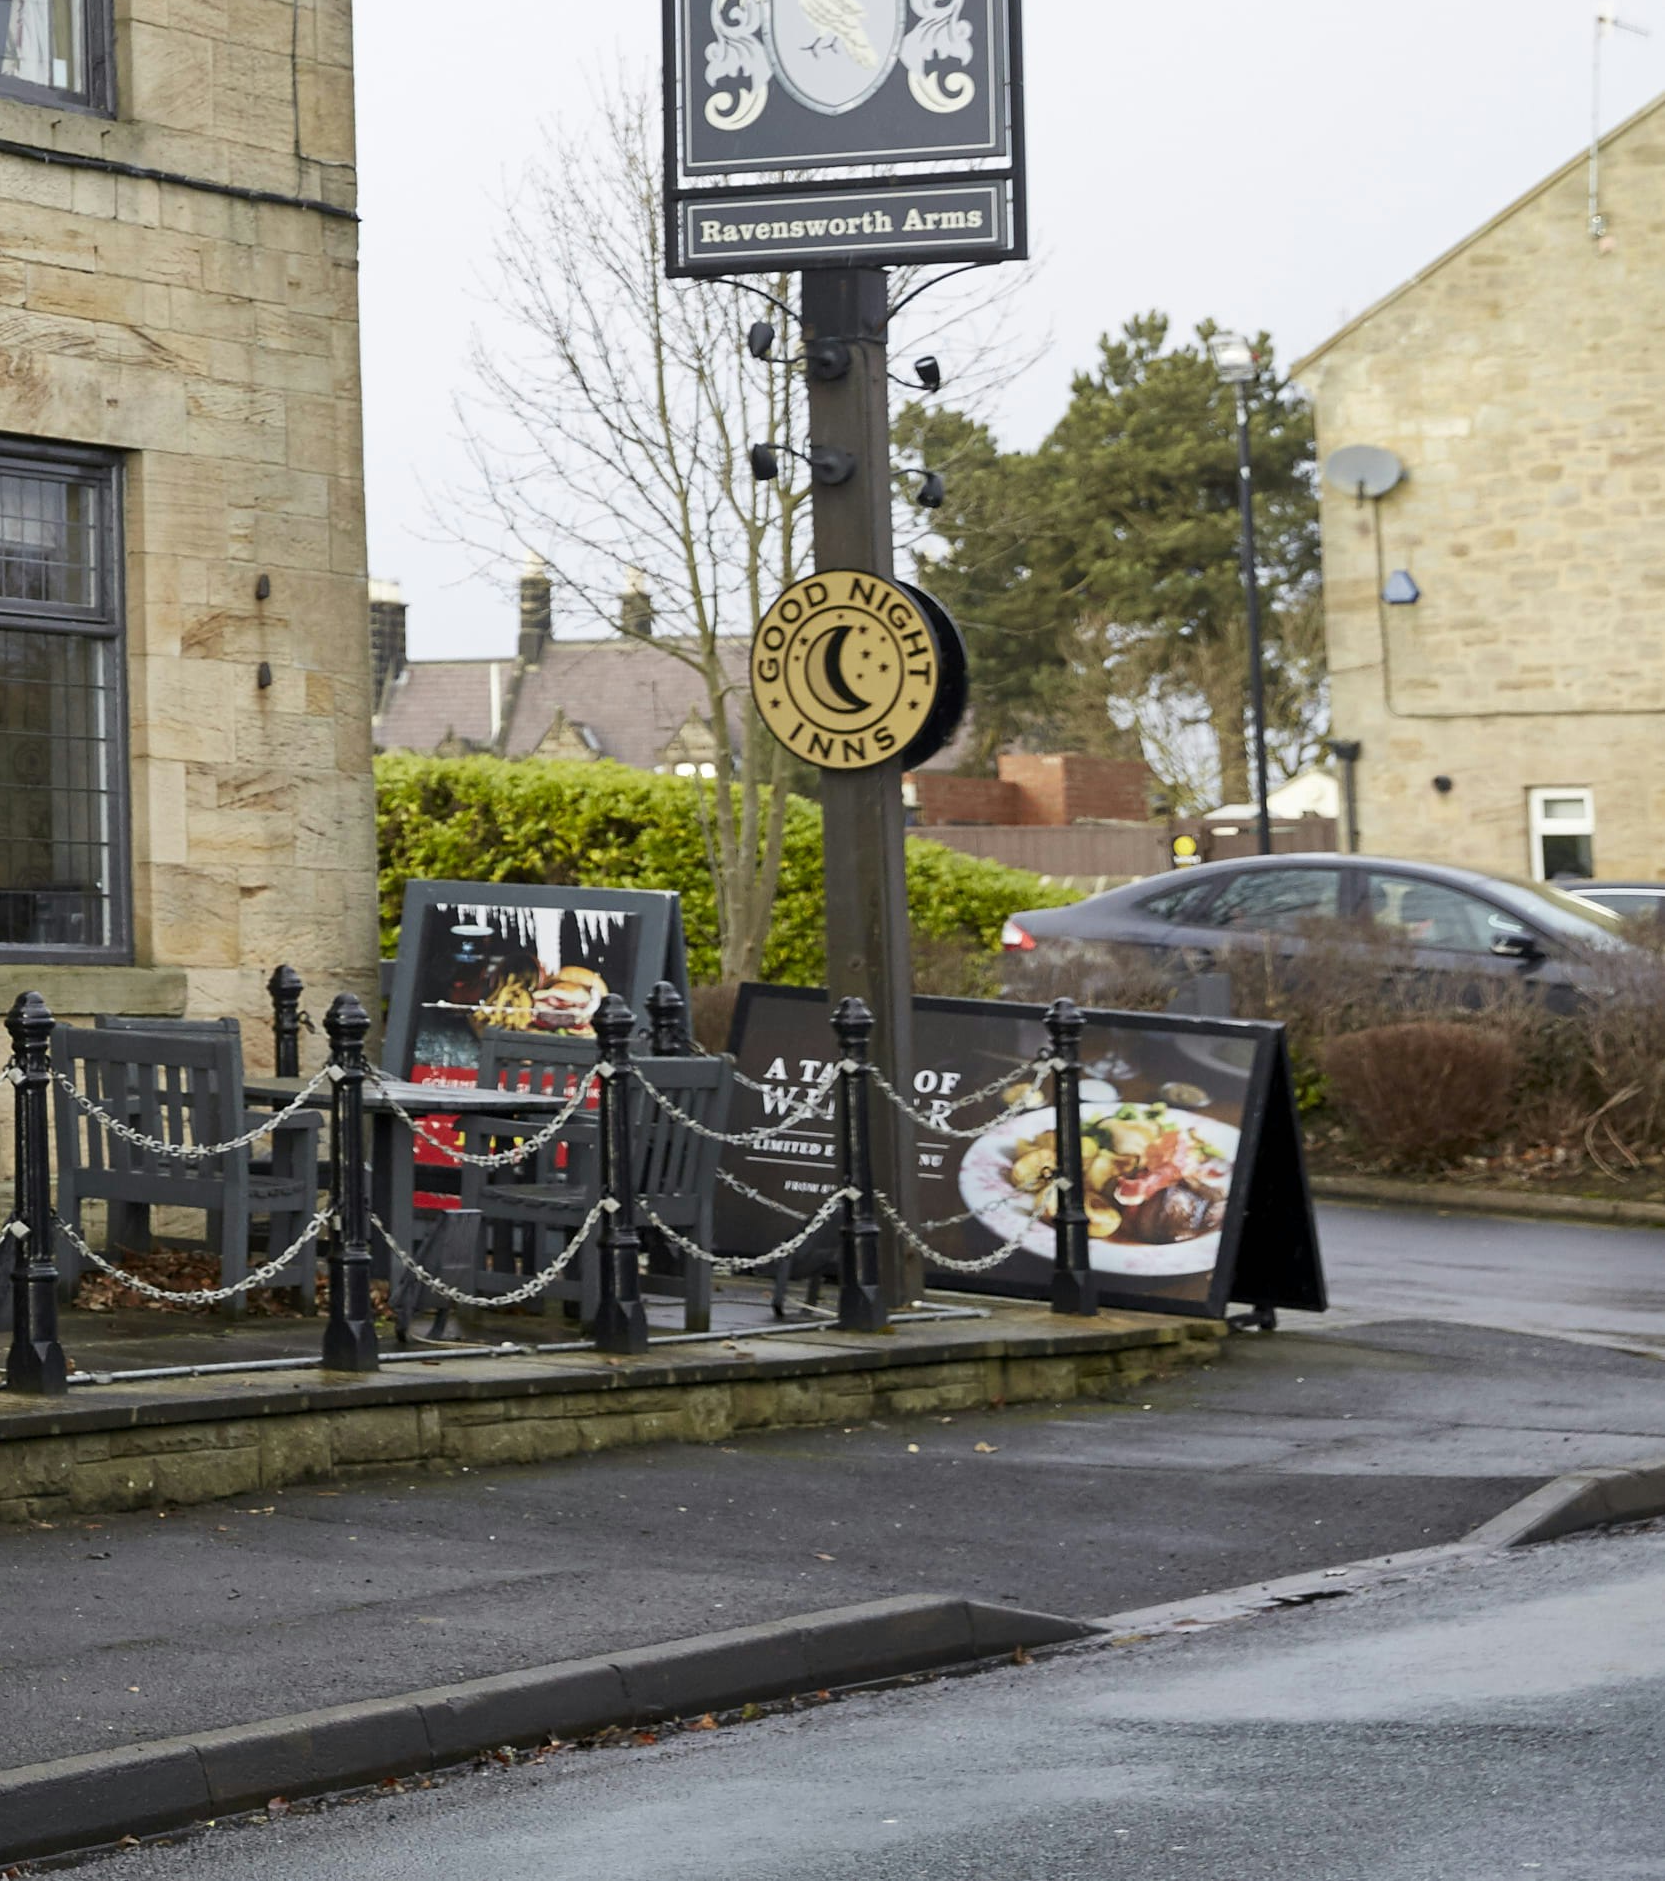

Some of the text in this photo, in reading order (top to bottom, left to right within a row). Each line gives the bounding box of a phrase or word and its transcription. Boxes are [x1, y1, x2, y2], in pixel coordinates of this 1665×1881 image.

[700, 208, 983, 243] Ravensworth Arms
[758, 577, 931, 686] GOOD NIGHT
[788, 722, 896, 762] INNS
[763, 1057, 789, 1080] A
[913, 1069, 961, 1095] OF
[753, 1138, 822, 1155] LIMITED
